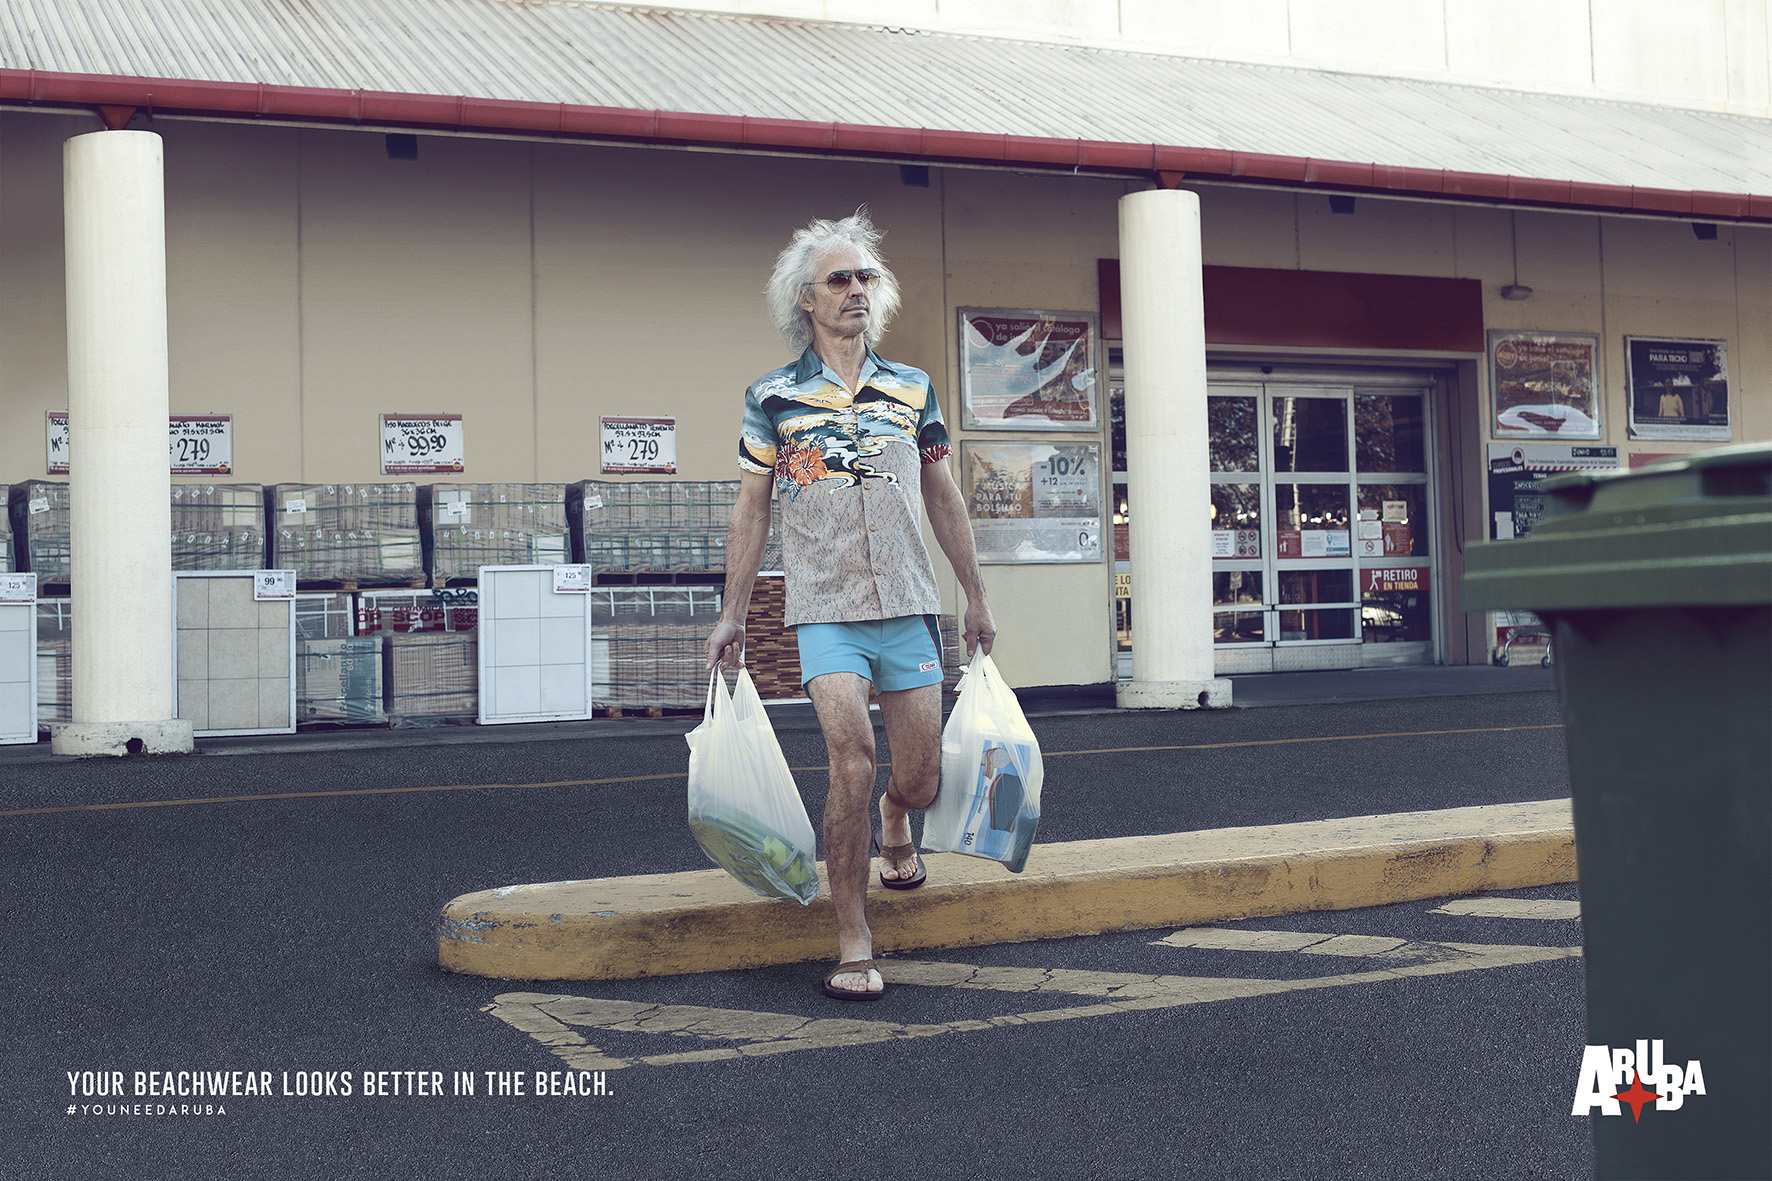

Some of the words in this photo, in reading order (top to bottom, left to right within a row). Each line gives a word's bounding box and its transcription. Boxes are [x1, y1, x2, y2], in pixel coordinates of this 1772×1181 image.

[995, 323, 1007, 331] ya
[1043, 324, 1080, 336] catálogo
[996, 332, 1008, 341] de
[1649, 354, 1668, 362] PARA
[177, 438, 210, 461] 279
[628, 438, 659, 460] 279
[1041, 477, 1058, 486] +12
[976, 493, 1001, 501] PARA
[1010, 493, 1022, 501] TU
[1383, 569, 1418, 581] RETIRO
[8, 581, 21, 589] 125
[264, 577, 275, 585] 99
[1383, 582, 1393, 590] EN
[1394, 581, 1418, 590] TIENDA
[392, 611, 445, 622] SCOP
[963, 832, 975, 846] 140
